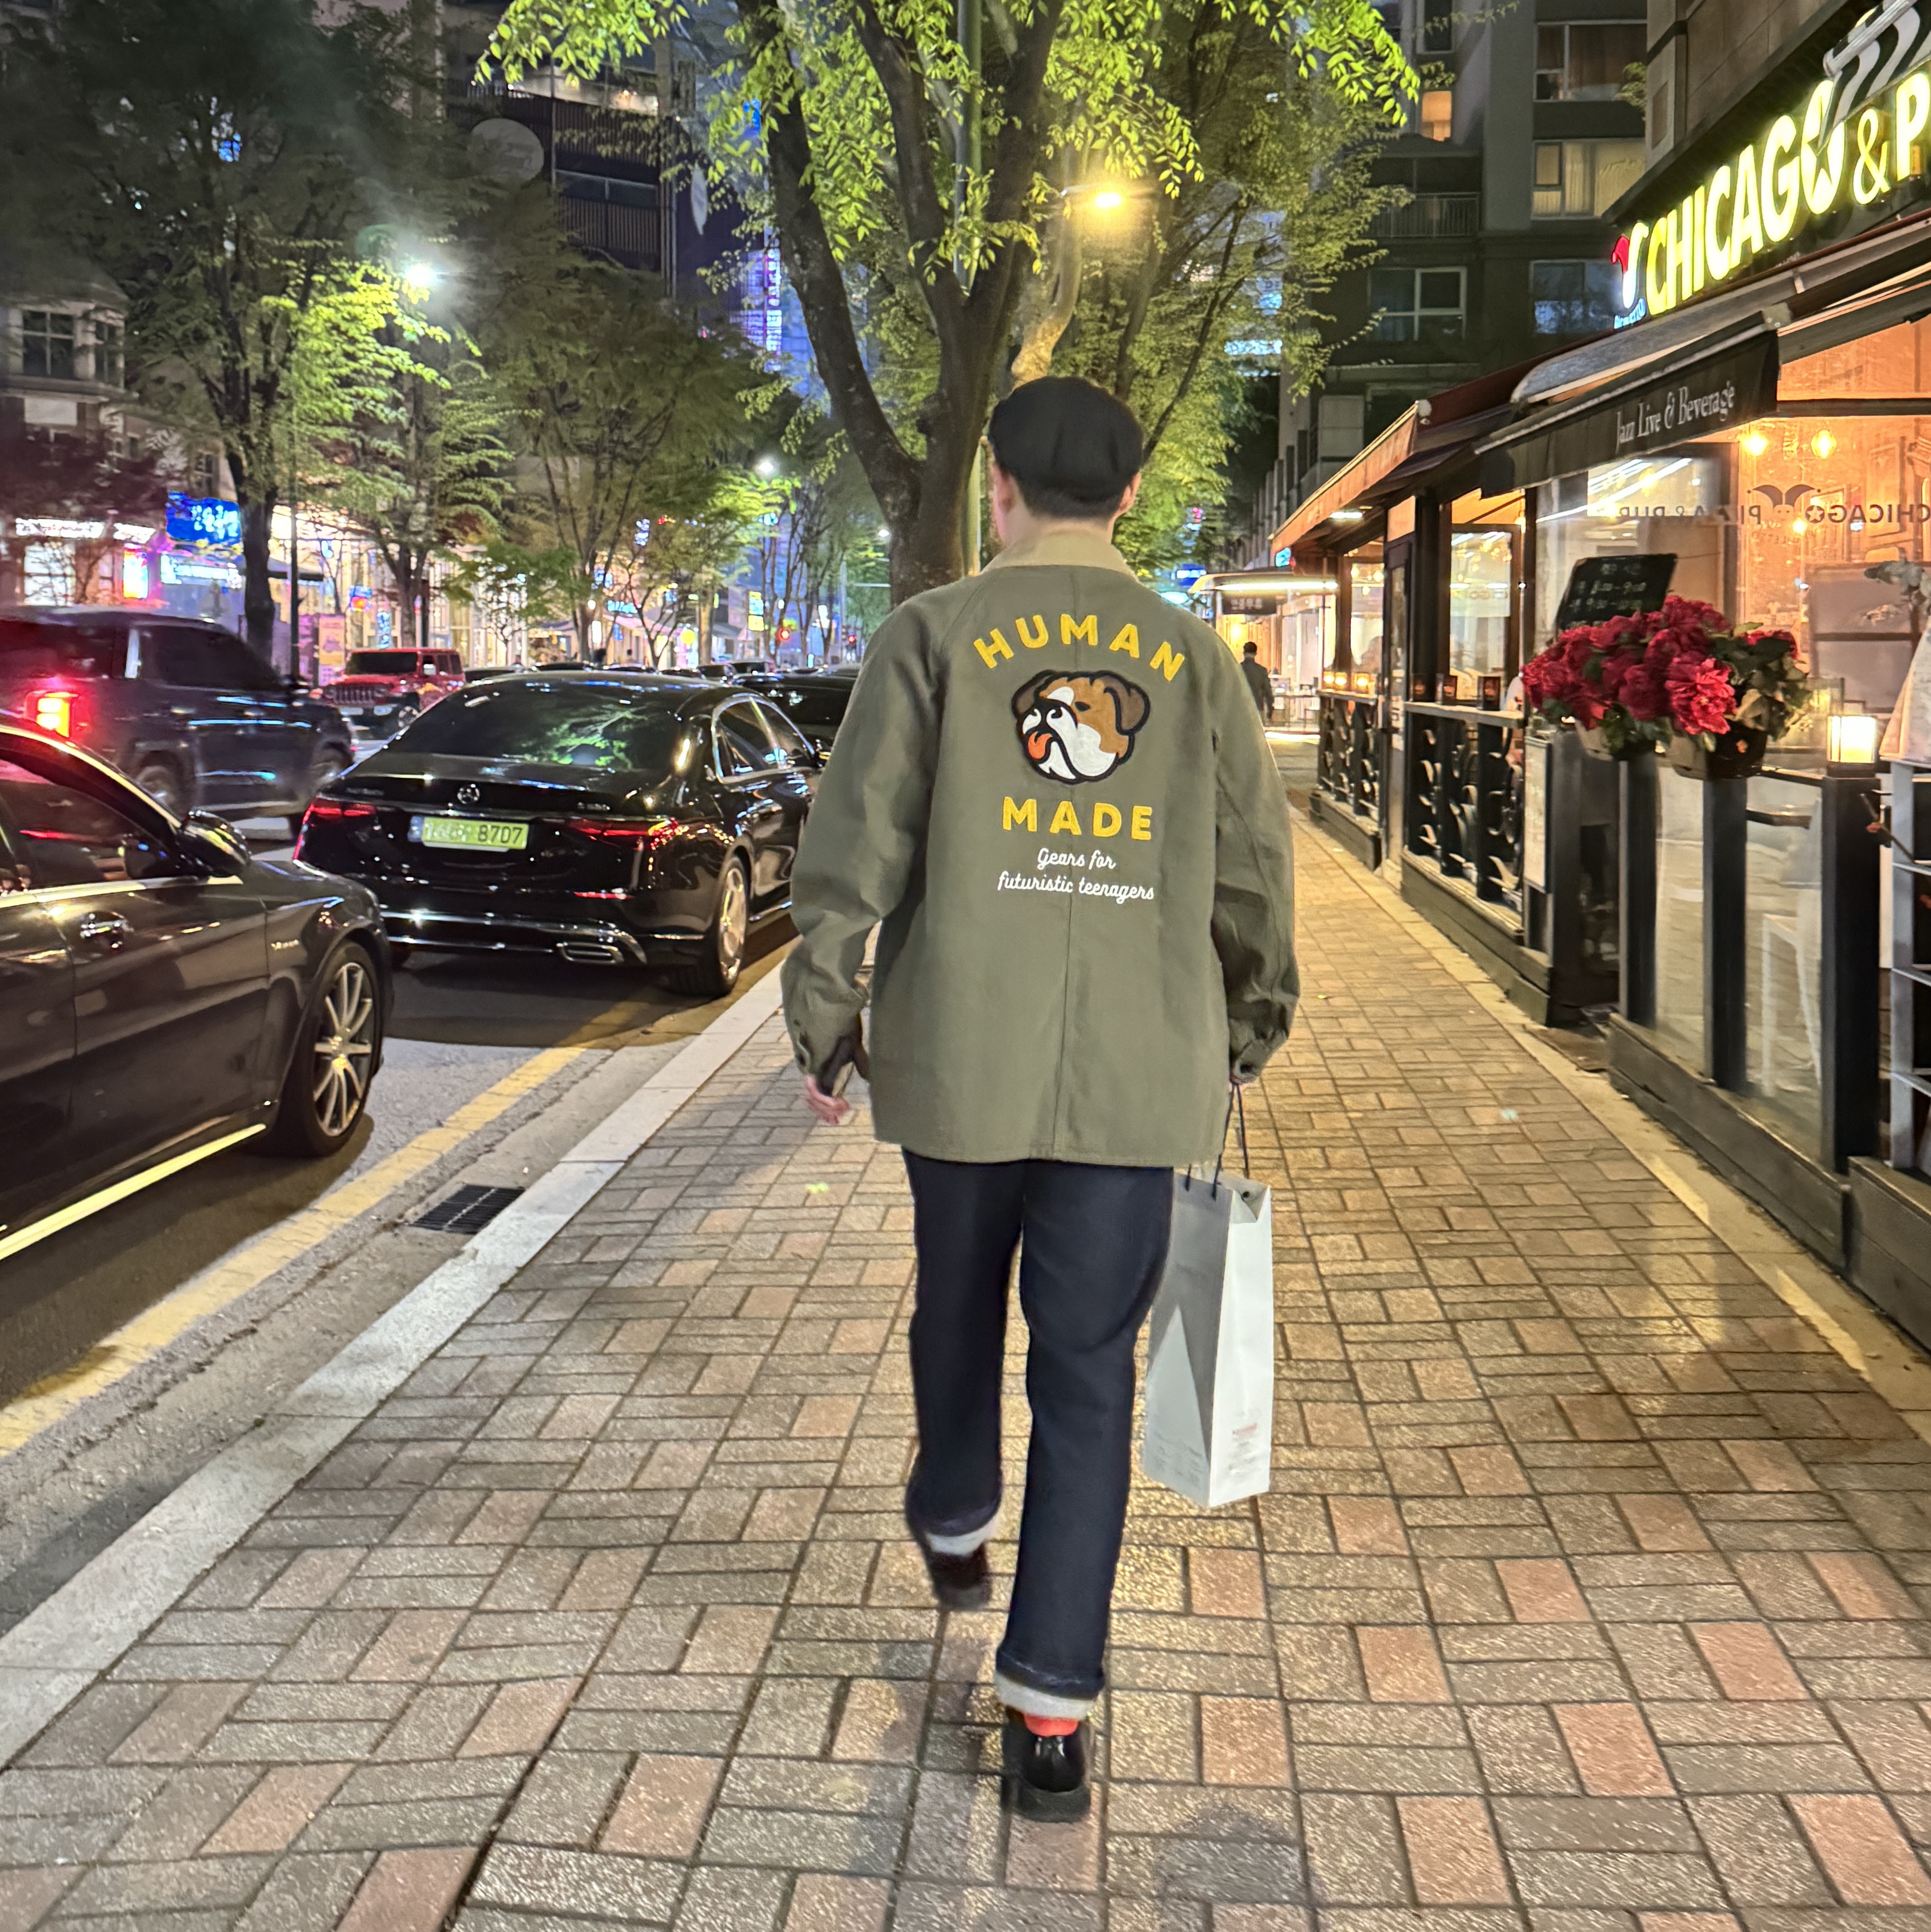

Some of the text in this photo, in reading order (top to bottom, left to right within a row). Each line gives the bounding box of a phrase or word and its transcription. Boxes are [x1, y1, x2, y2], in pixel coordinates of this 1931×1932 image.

[1646, 80, 1845, 315] CHICAGO
[1853, 109, 1890, 204] &
[1637, 401, 1661, 437] Live
[1664, 391, 1675, 429] &
[1677, 380, 1735, 421] Beverage
[974, 614, 1185, 681] HUMAN
[478, 824, 523, 844] 8707
[1002, 796, 1152, 840] MADE
[1037, 848, 1116, 869] Gears for
[997, 871, 1155, 904] futuristic teenagers
